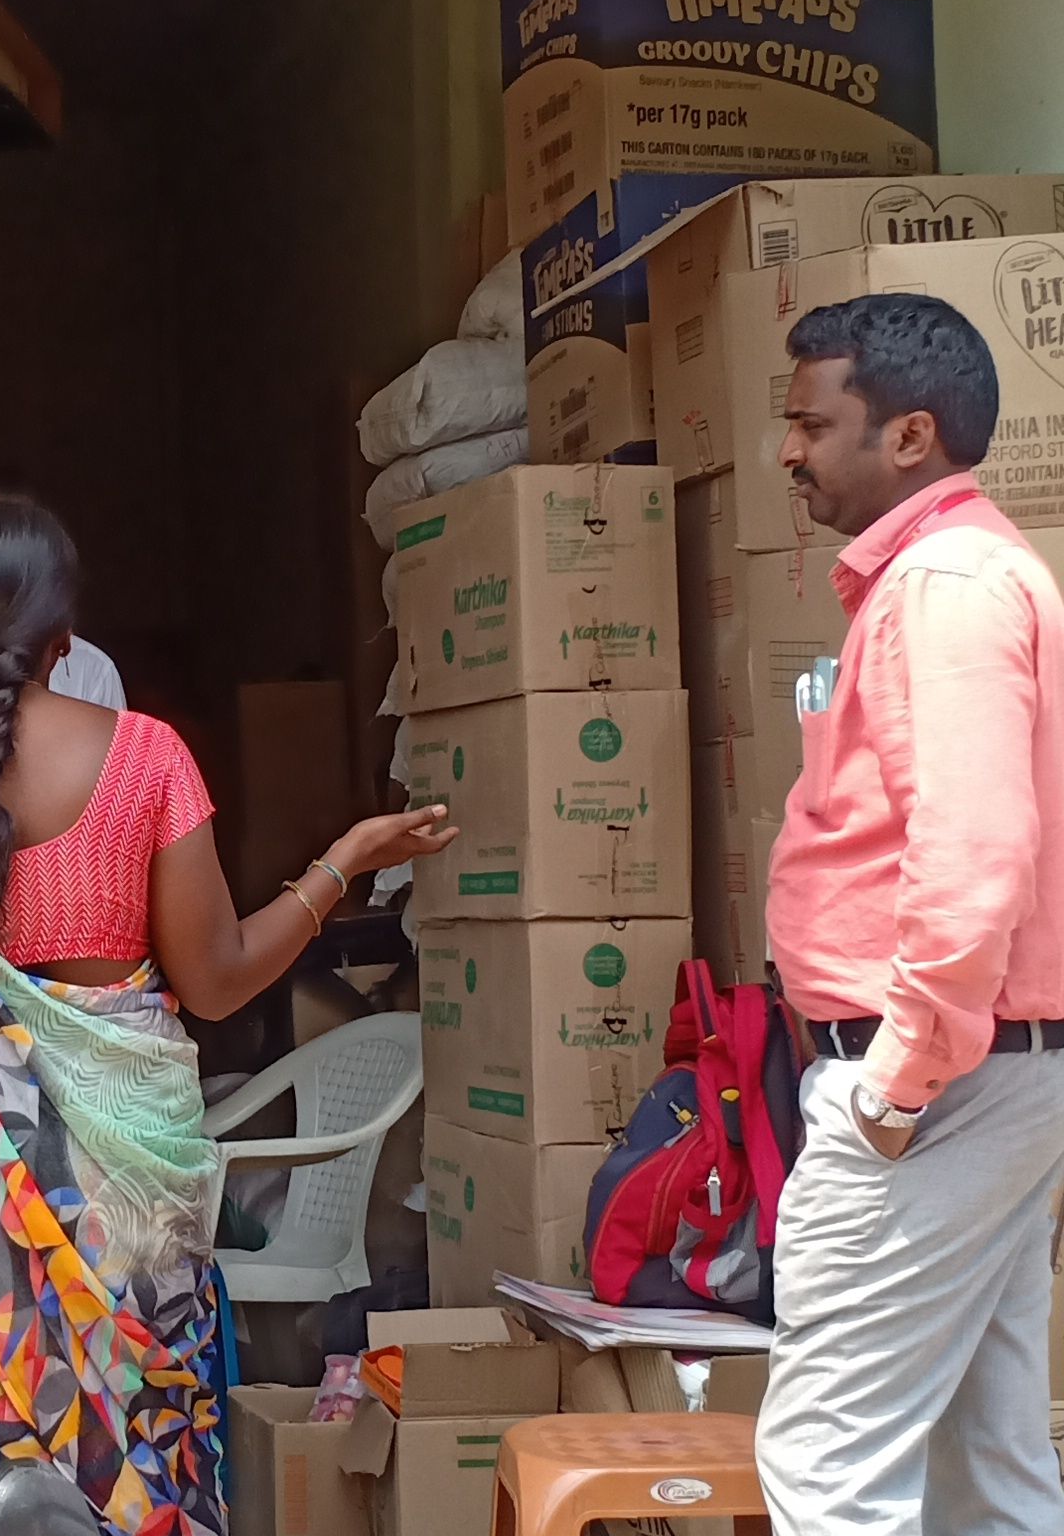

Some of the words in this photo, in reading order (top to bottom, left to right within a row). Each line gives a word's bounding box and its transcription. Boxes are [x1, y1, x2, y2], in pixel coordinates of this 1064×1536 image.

[756, 41, 879, 105] CHIPS
[670, 105, 701, 128] 17g
[707, 107, 748, 129] pack
[621, 141, 645, 154] THIS
[648, 142, 690, 156] CARTON
[693, 144, 744, 158] CONTAINS
[768, 147, 801, 161] PACKS
[804, 149, 817, 161] OF
[982, 443, 1043, 463] RFORD
[648, 491, 659, 505] 6
